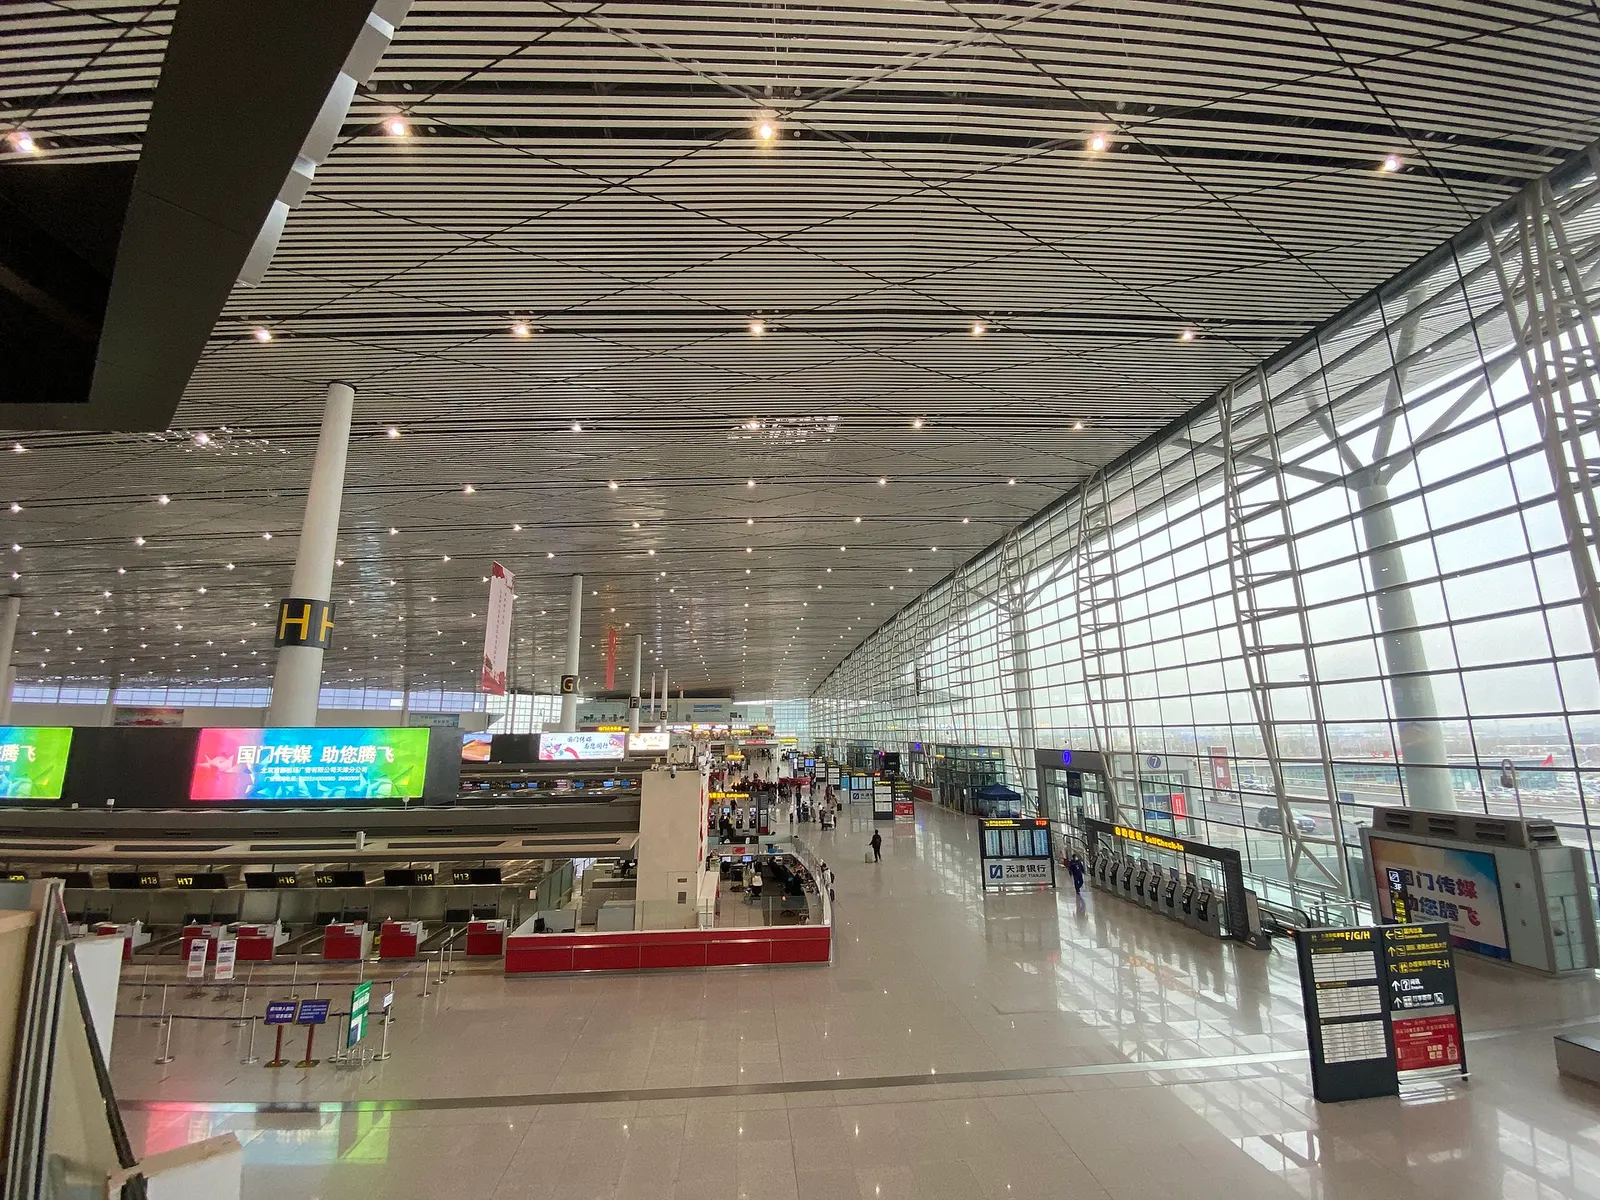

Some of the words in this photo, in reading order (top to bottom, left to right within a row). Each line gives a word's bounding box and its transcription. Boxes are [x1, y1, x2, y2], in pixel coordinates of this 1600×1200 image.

[279, 603, 311, 640] H
[562, 677, 574, 694] G
[632, 698, 638, 707] F
[0, 744, 37, 762] 腾飞
[236, 745, 313, 764] 国门传媒
[320, 745, 395, 764] 助您腾飞
[1151, 756, 1158, 767] 7
[1006, 865, 1046, 873] 天津银行
[141, 876, 158, 885] H18
[177, 877, 193, 885] H17
[278, 876, 295, 885] H16
[316, 875, 333, 884] H15
[417, 873, 433, 882] H14
[453, 872, 470, 881] H13
[1345, 931, 1371, 941] F/G/H
[1437, 959, 1450, 969] E-H
